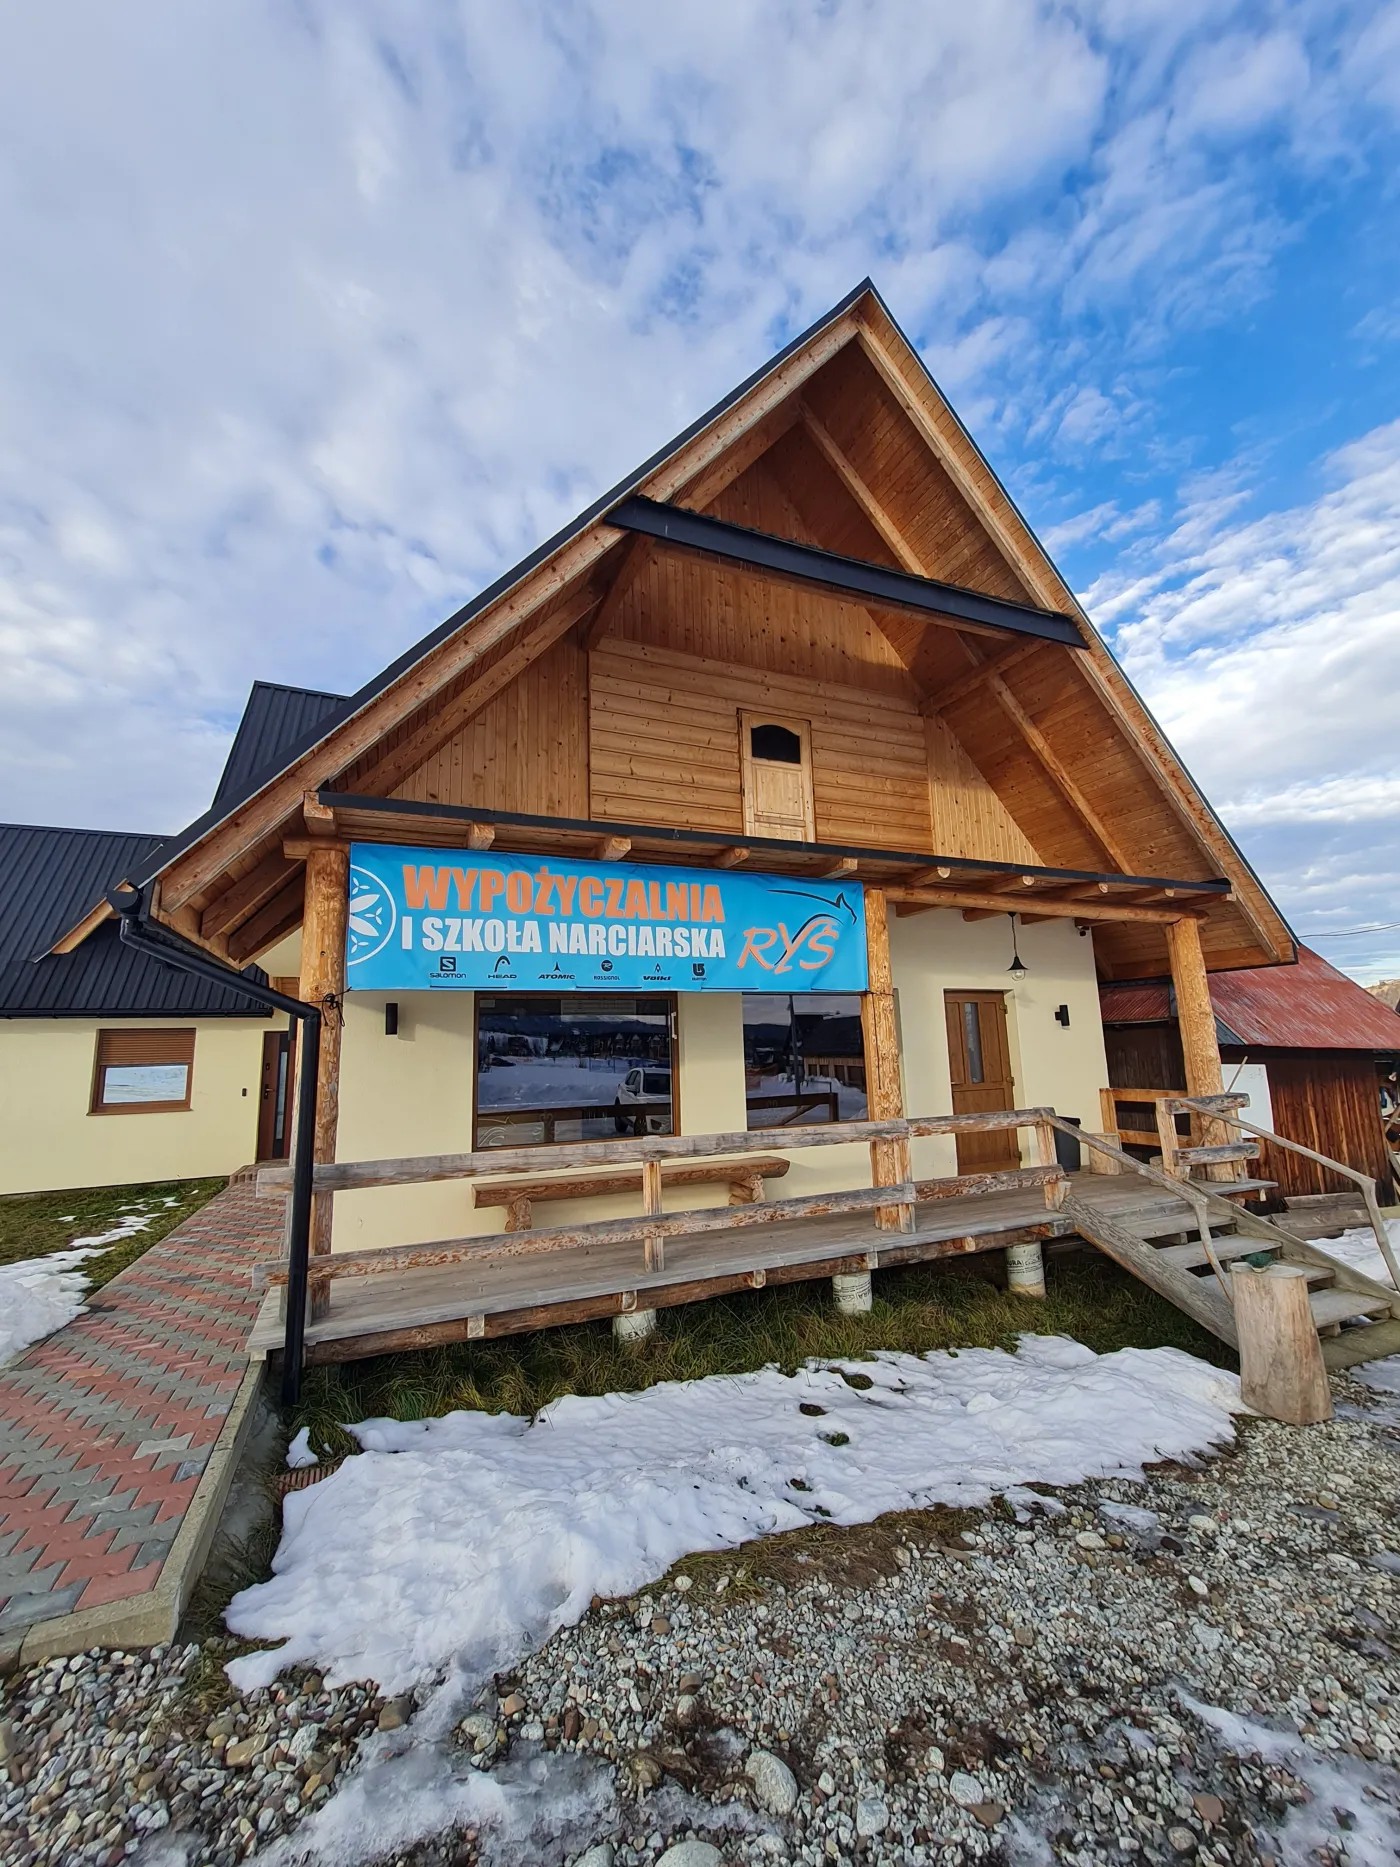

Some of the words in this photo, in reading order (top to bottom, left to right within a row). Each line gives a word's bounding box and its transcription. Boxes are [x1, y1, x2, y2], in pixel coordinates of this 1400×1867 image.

[402, 864, 726, 924] WYPOŻYCZALNIA
[402, 916, 413, 950] I
[422, 917, 543, 953] SZKOŁA
[550, 922, 727, 959] NARCIARSKA
